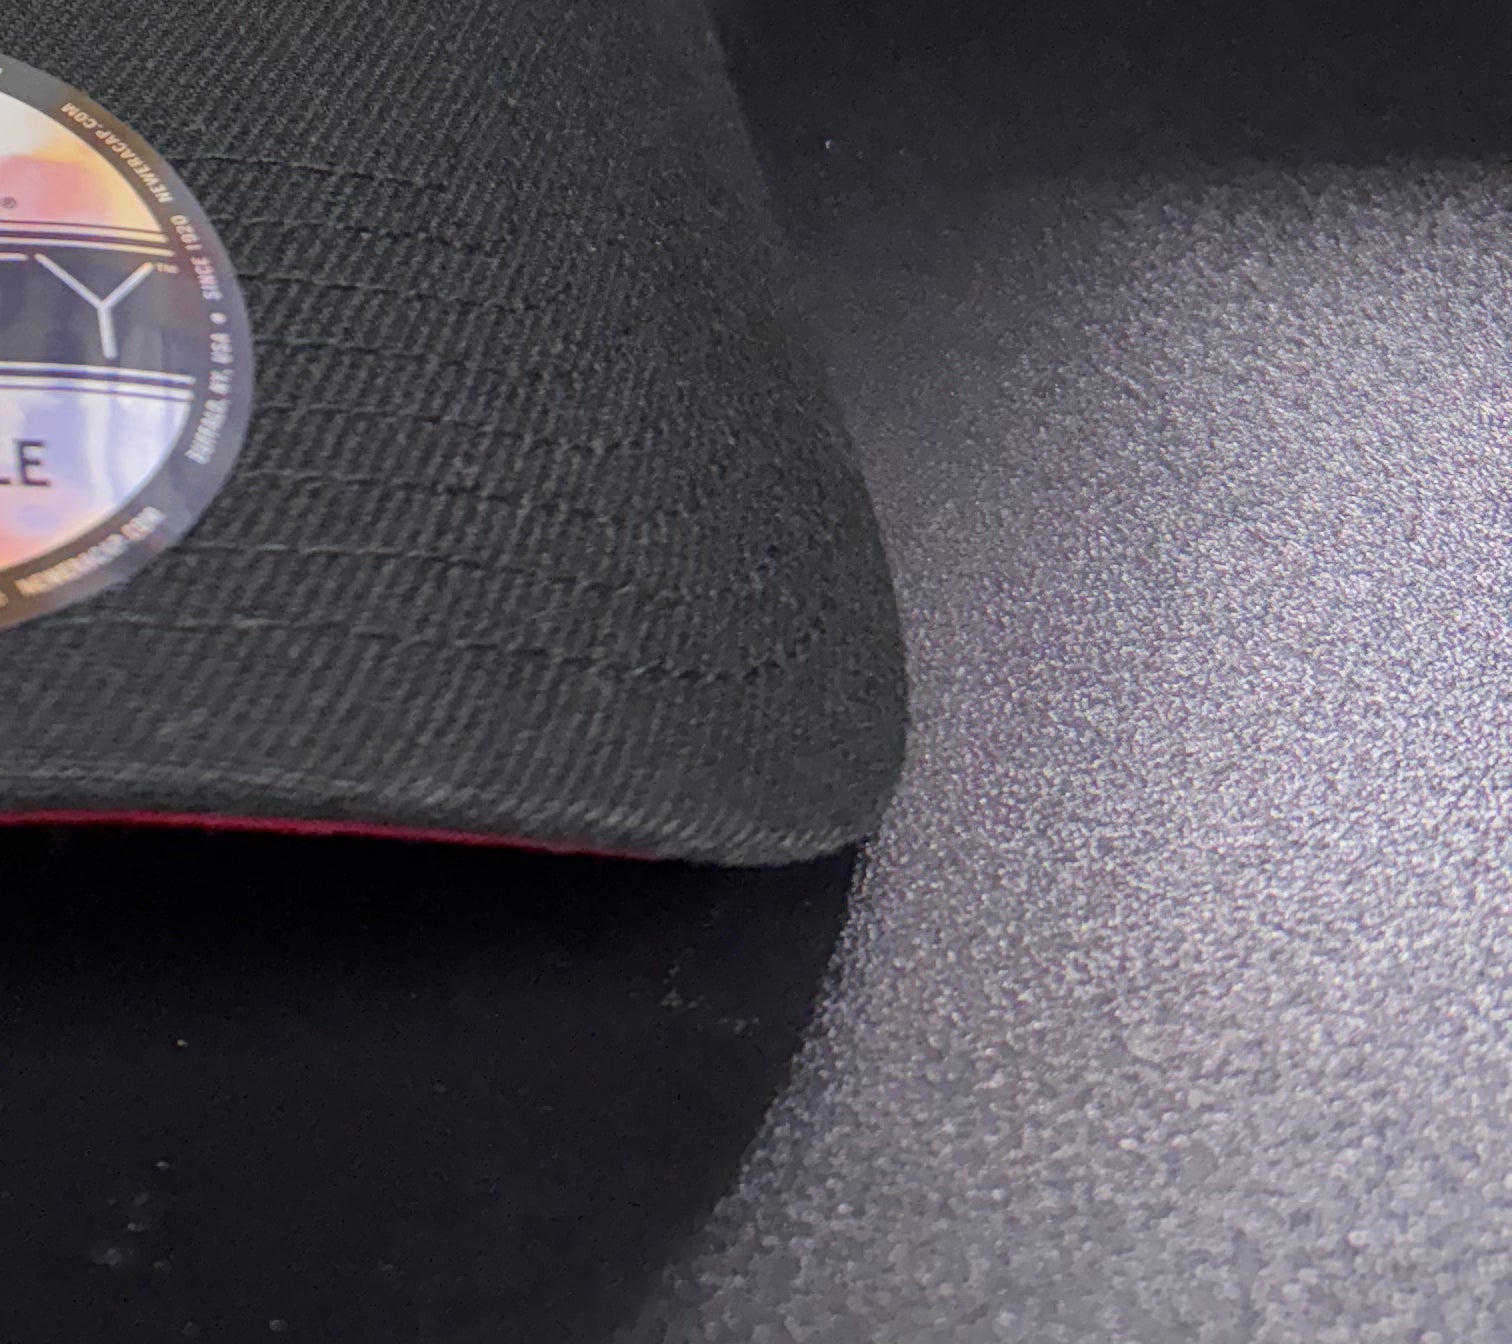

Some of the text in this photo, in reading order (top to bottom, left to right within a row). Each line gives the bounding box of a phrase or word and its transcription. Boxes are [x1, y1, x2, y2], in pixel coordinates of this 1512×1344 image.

[60, 102, 175, 203] NEWERACAP.COM
[170, 214, 202, 252] 1920
[190, 256, 223, 301] SINCE
